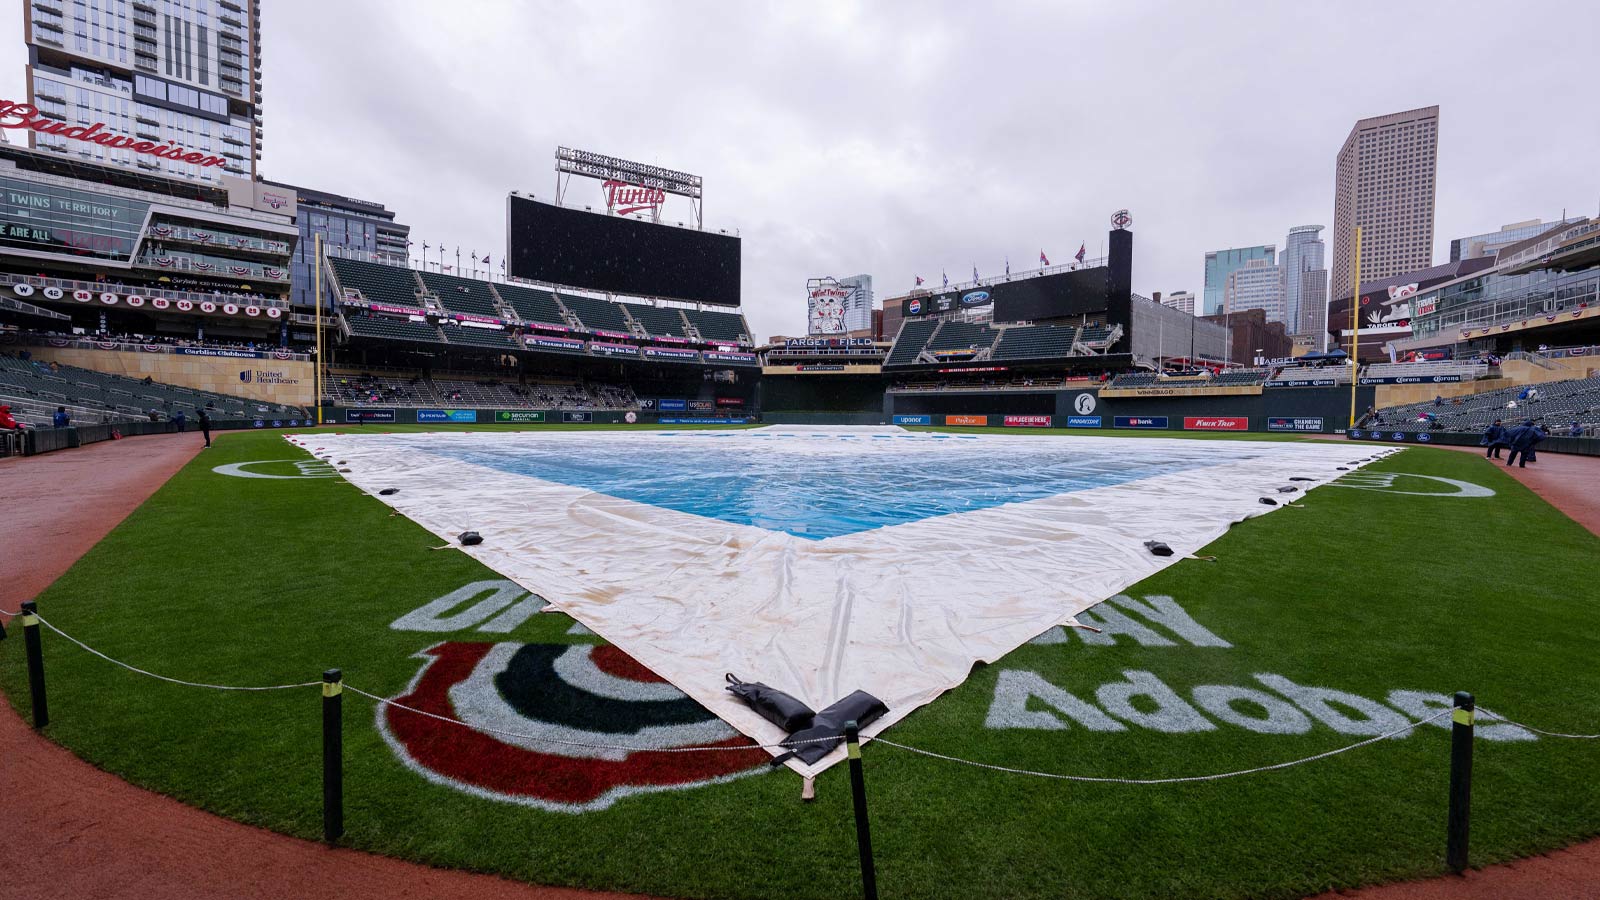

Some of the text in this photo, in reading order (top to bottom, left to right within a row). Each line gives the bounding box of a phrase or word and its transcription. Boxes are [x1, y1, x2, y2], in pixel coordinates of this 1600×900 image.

[0, 100, 226, 167] Budweiser
[604, 180, 666, 210] Twins
[9, 193, 118, 217] TWINS TERRITORY
[10, 226, 29, 238] ARE
[32, 229, 50, 240] ALL
[539, 340, 563, 348] Treasure
[786, 338, 872, 346] TARGET FIELD
[217, 350, 256, 358] Clubhouse
[1262, 357, 1295, 365] ARGET
[256, 376, 299, 384] Healthcare
[1195, 419, 1236, 427] KWIK TRIP
[1029, 594, 1233, 648] AY
[984, 669, 1538, 742] Adobe
